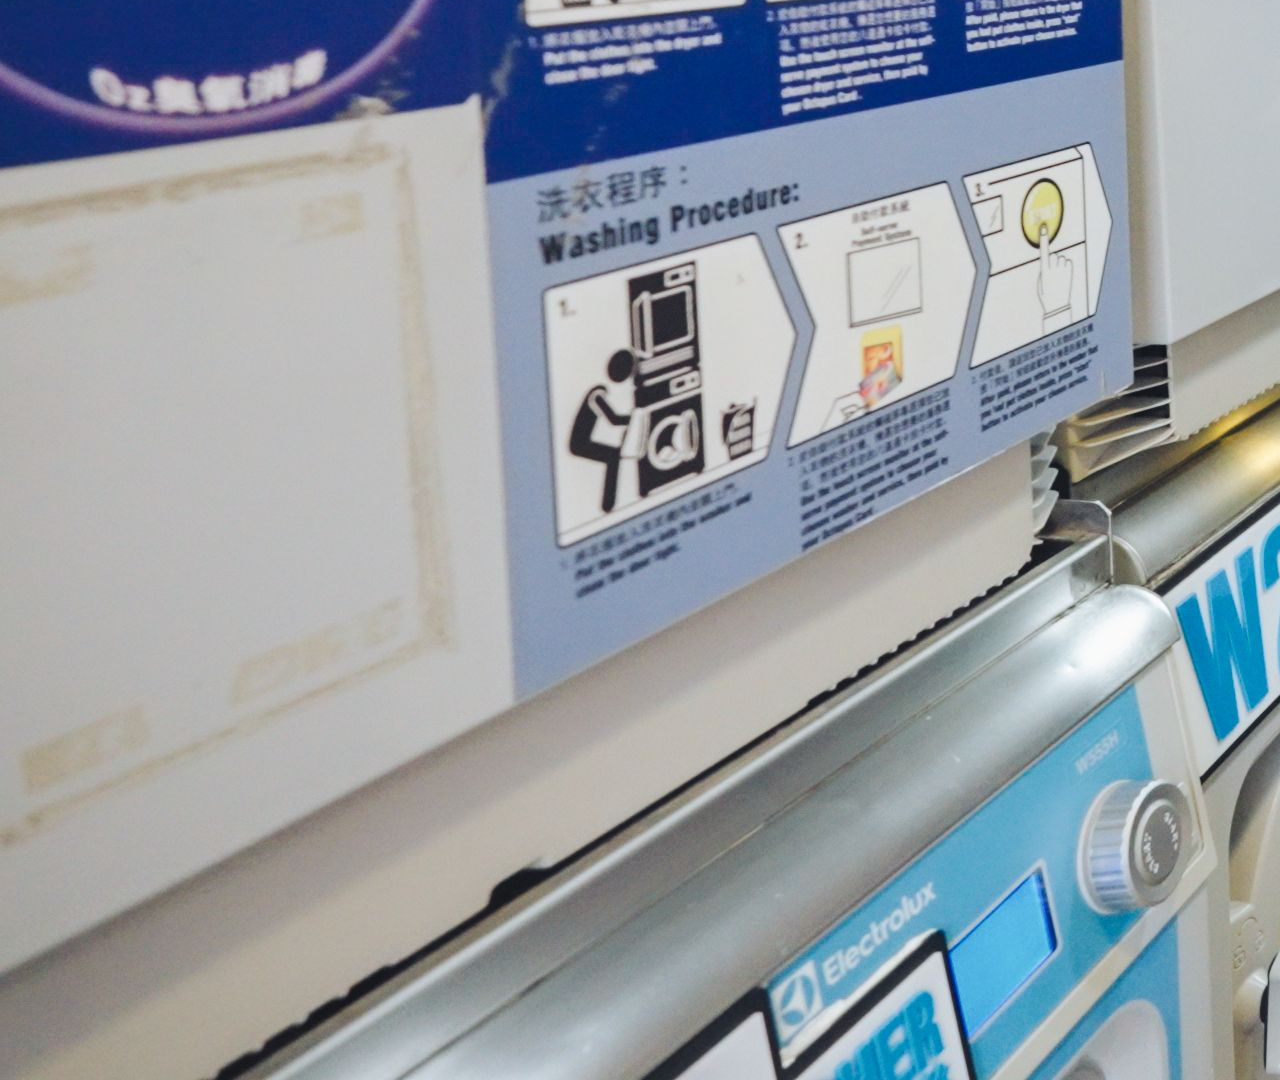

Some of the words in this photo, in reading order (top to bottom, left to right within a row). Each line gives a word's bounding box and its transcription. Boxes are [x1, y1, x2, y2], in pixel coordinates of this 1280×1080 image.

[539, 215, 661, 266] Washing
[670, 182, 801, 232] Procedure:
[821, 879, 938, 988] Electrolux
